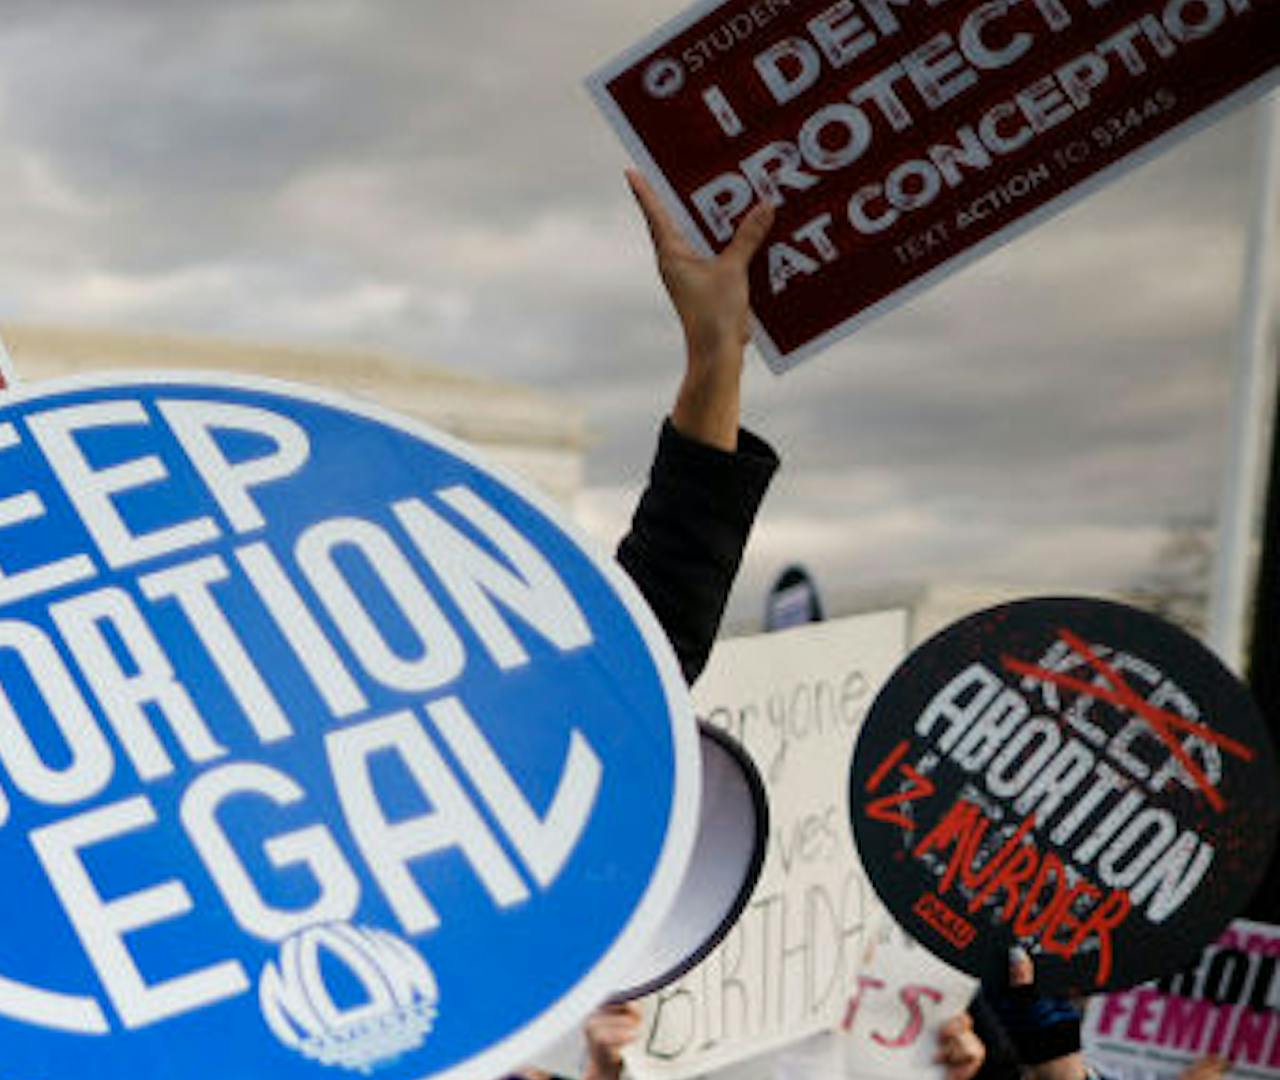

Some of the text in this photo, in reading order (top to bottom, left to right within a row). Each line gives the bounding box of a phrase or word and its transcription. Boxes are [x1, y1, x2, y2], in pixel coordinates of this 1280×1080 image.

[689, 0, 1072, 242] PROTEC
[702, 84, 745, 137] I
[766, 0, 1252, 294] AT CONCEPTIO
[894, 222, 952, 264] TEXT
[956, 163, 1050, 229] ACTION
[706, 669, 873, 785] eryone
[914, 661, 1216, 925] ABORTION
[914, 799, 1132, 987] MURDER
